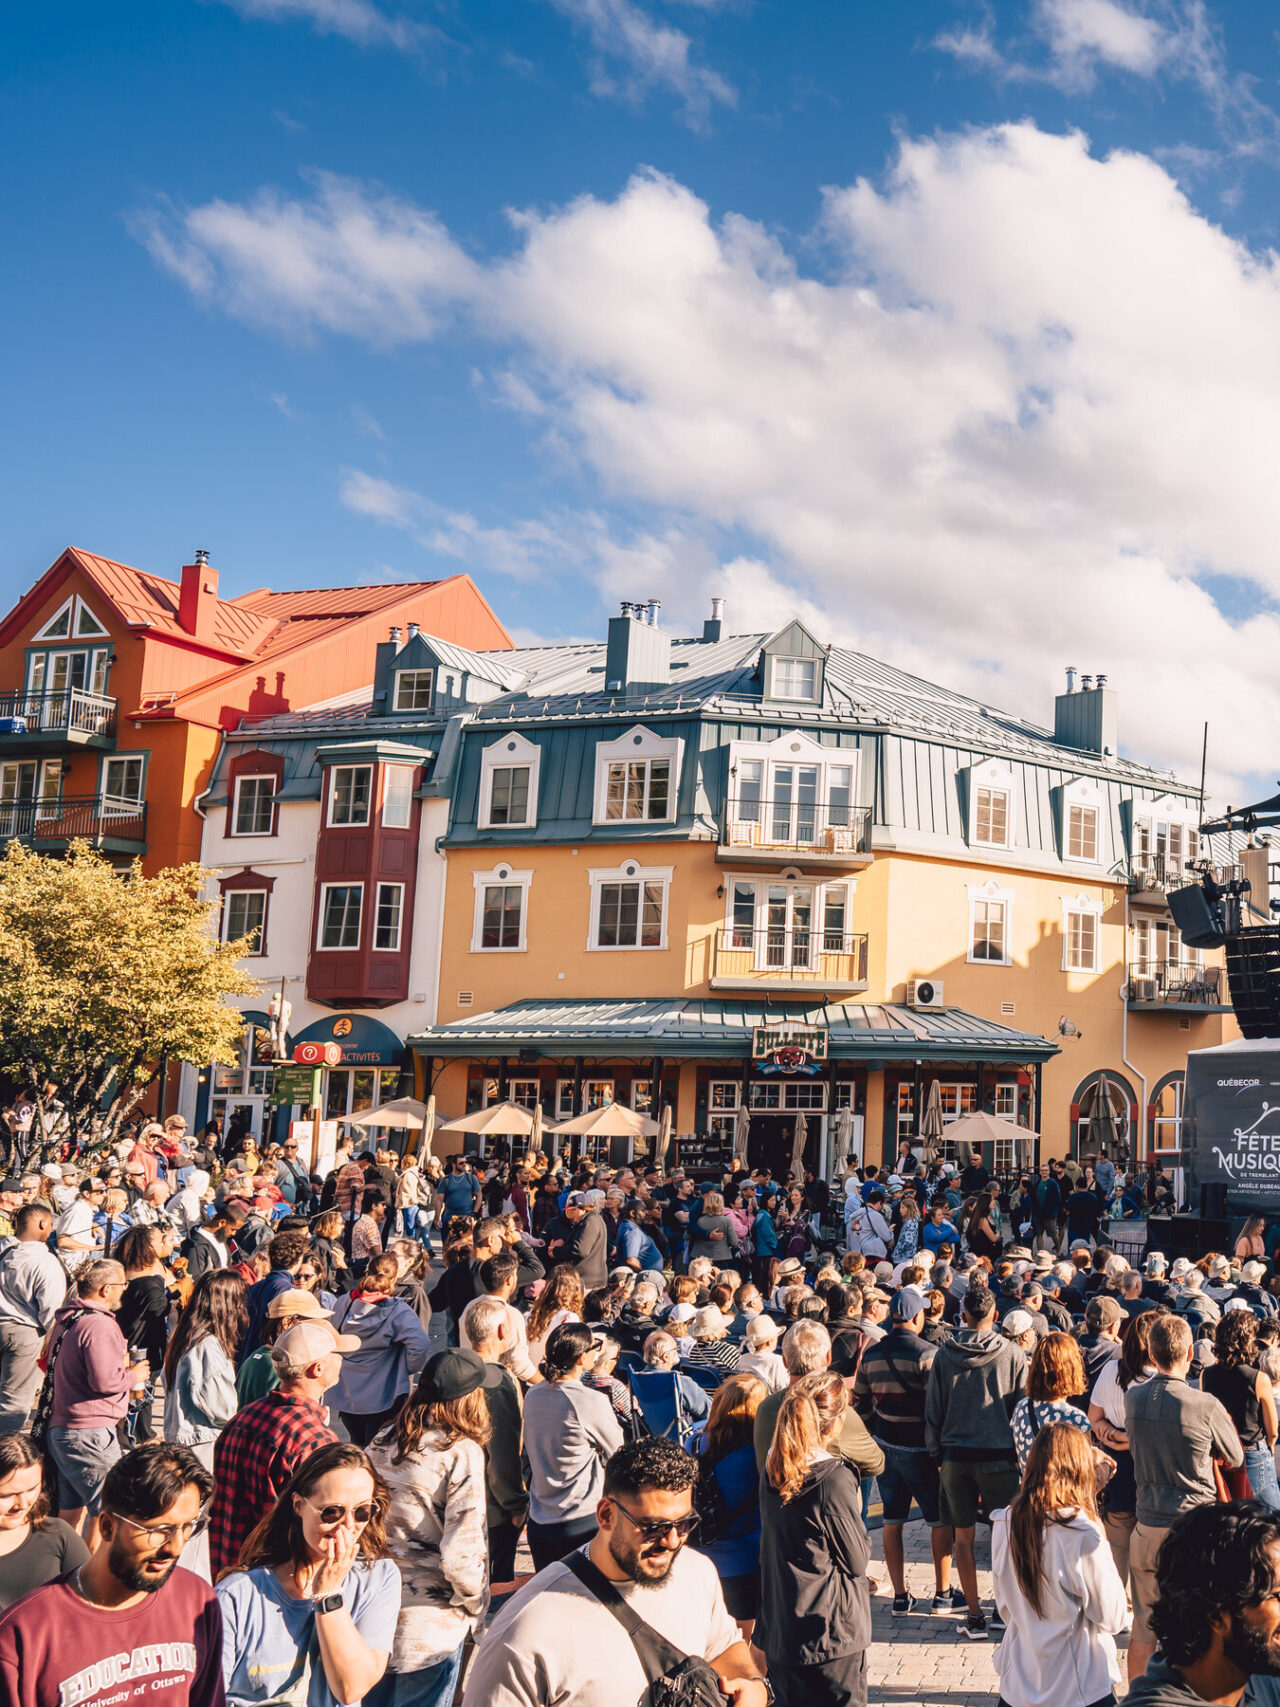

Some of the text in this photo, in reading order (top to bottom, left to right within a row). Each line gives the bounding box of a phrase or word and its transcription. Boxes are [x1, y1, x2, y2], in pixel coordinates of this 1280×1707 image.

[756, 1030, 825, 1056] BULLSEYE
[1216, 1078, 1260, 1087] QUÉBECOR
[59, 1641, 197, 1707] EDUCATION
[133, 1683, 147, 1696] of
[151, 1674, 186, 1691] Ottawa
